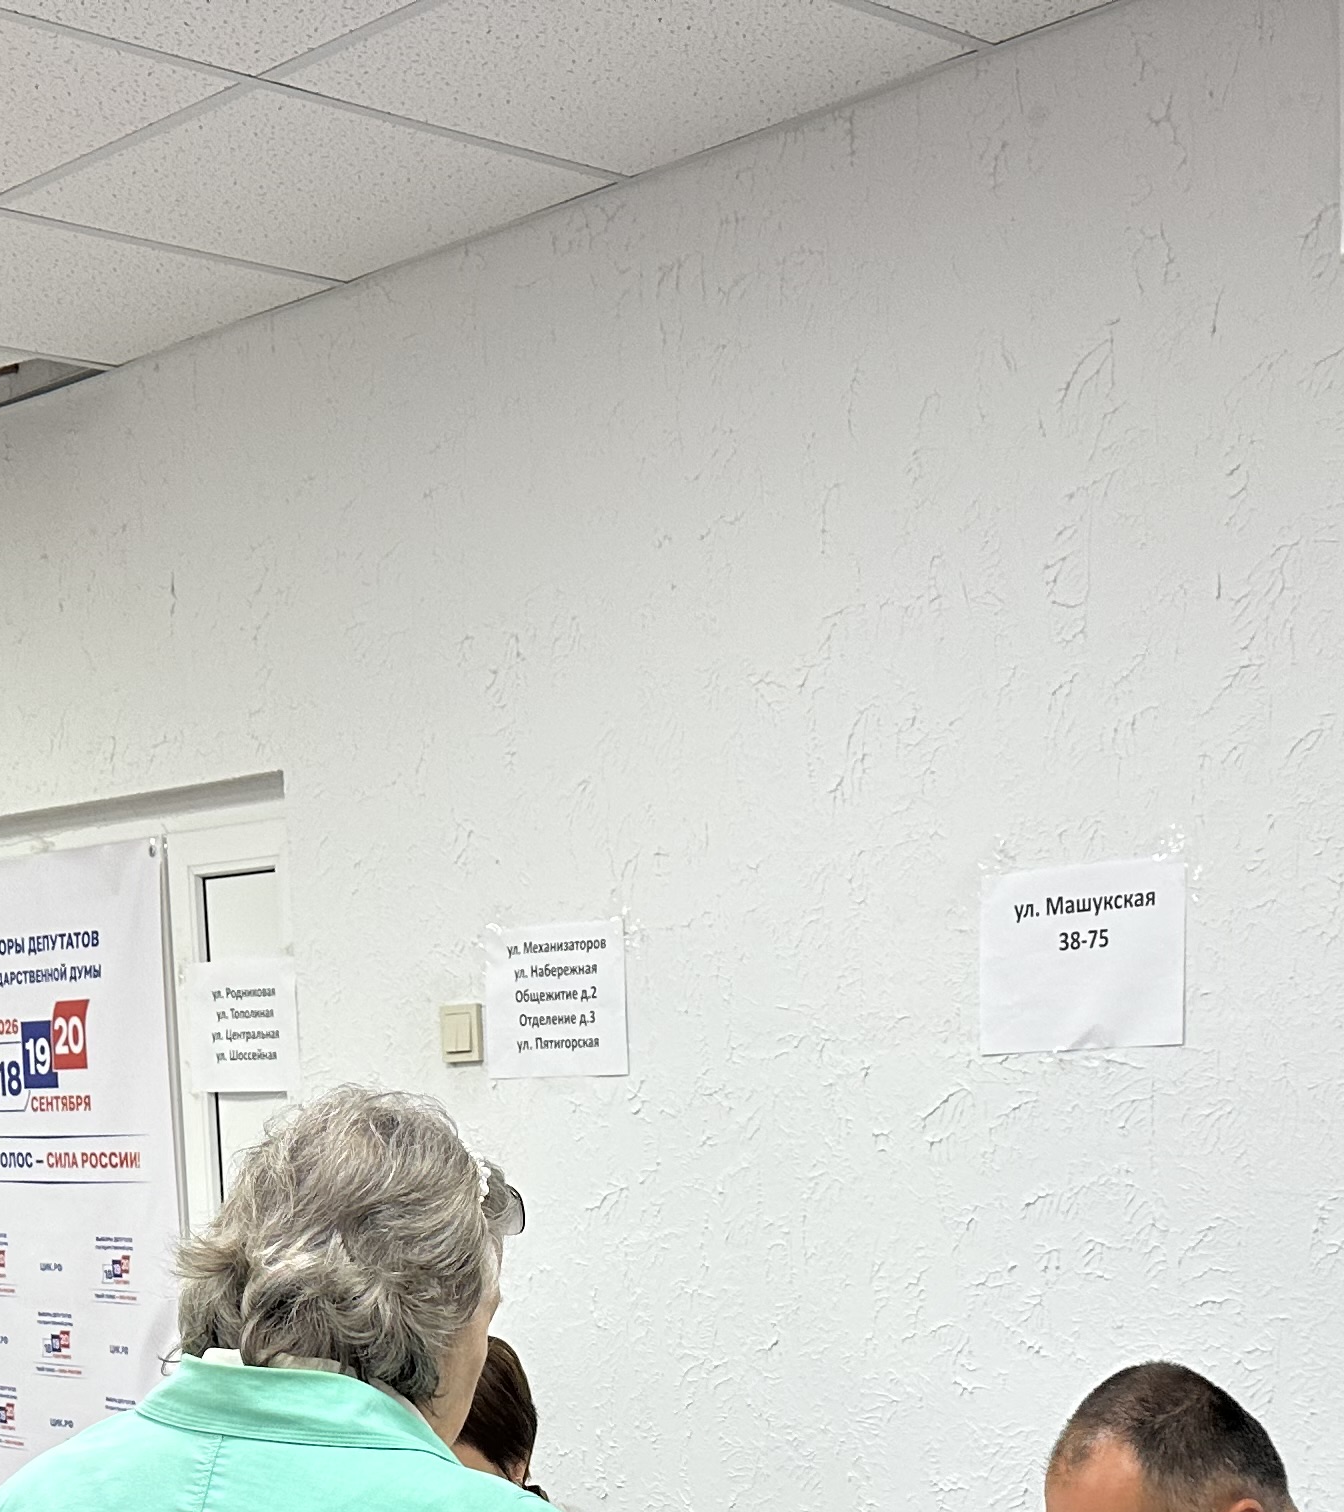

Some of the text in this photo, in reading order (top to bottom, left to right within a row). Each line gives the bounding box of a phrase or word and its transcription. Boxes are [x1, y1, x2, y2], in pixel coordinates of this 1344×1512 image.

[1014, 891, 1156, 923] ул. Машукская
[28, 930, 100, 955] ДЕПУТАТОВ
[506, 938, 607, 959] ул. Механизаторов
[1059, 929, 1109, 951] 38-75
[69, 964, 102, 983] ДУМЫ
[514, 963, 598, 982] ул. Набережная
[515, 986, 598, 1004] Общежитие д.2
[519, 1010, 596, 1028] Отделение д.3
[54, 1015, 84, 1055] 20
[517, 1037, 600, 1053] ул. Пятигорская
[25, 1037, 52, 1075] 19
[31, 1094, 91, 1112] СЕНТЯБРЯ
[46, 1151, 78, 1169] СИЛА
[81, 1151, 141, 1169] РОССИИ!
